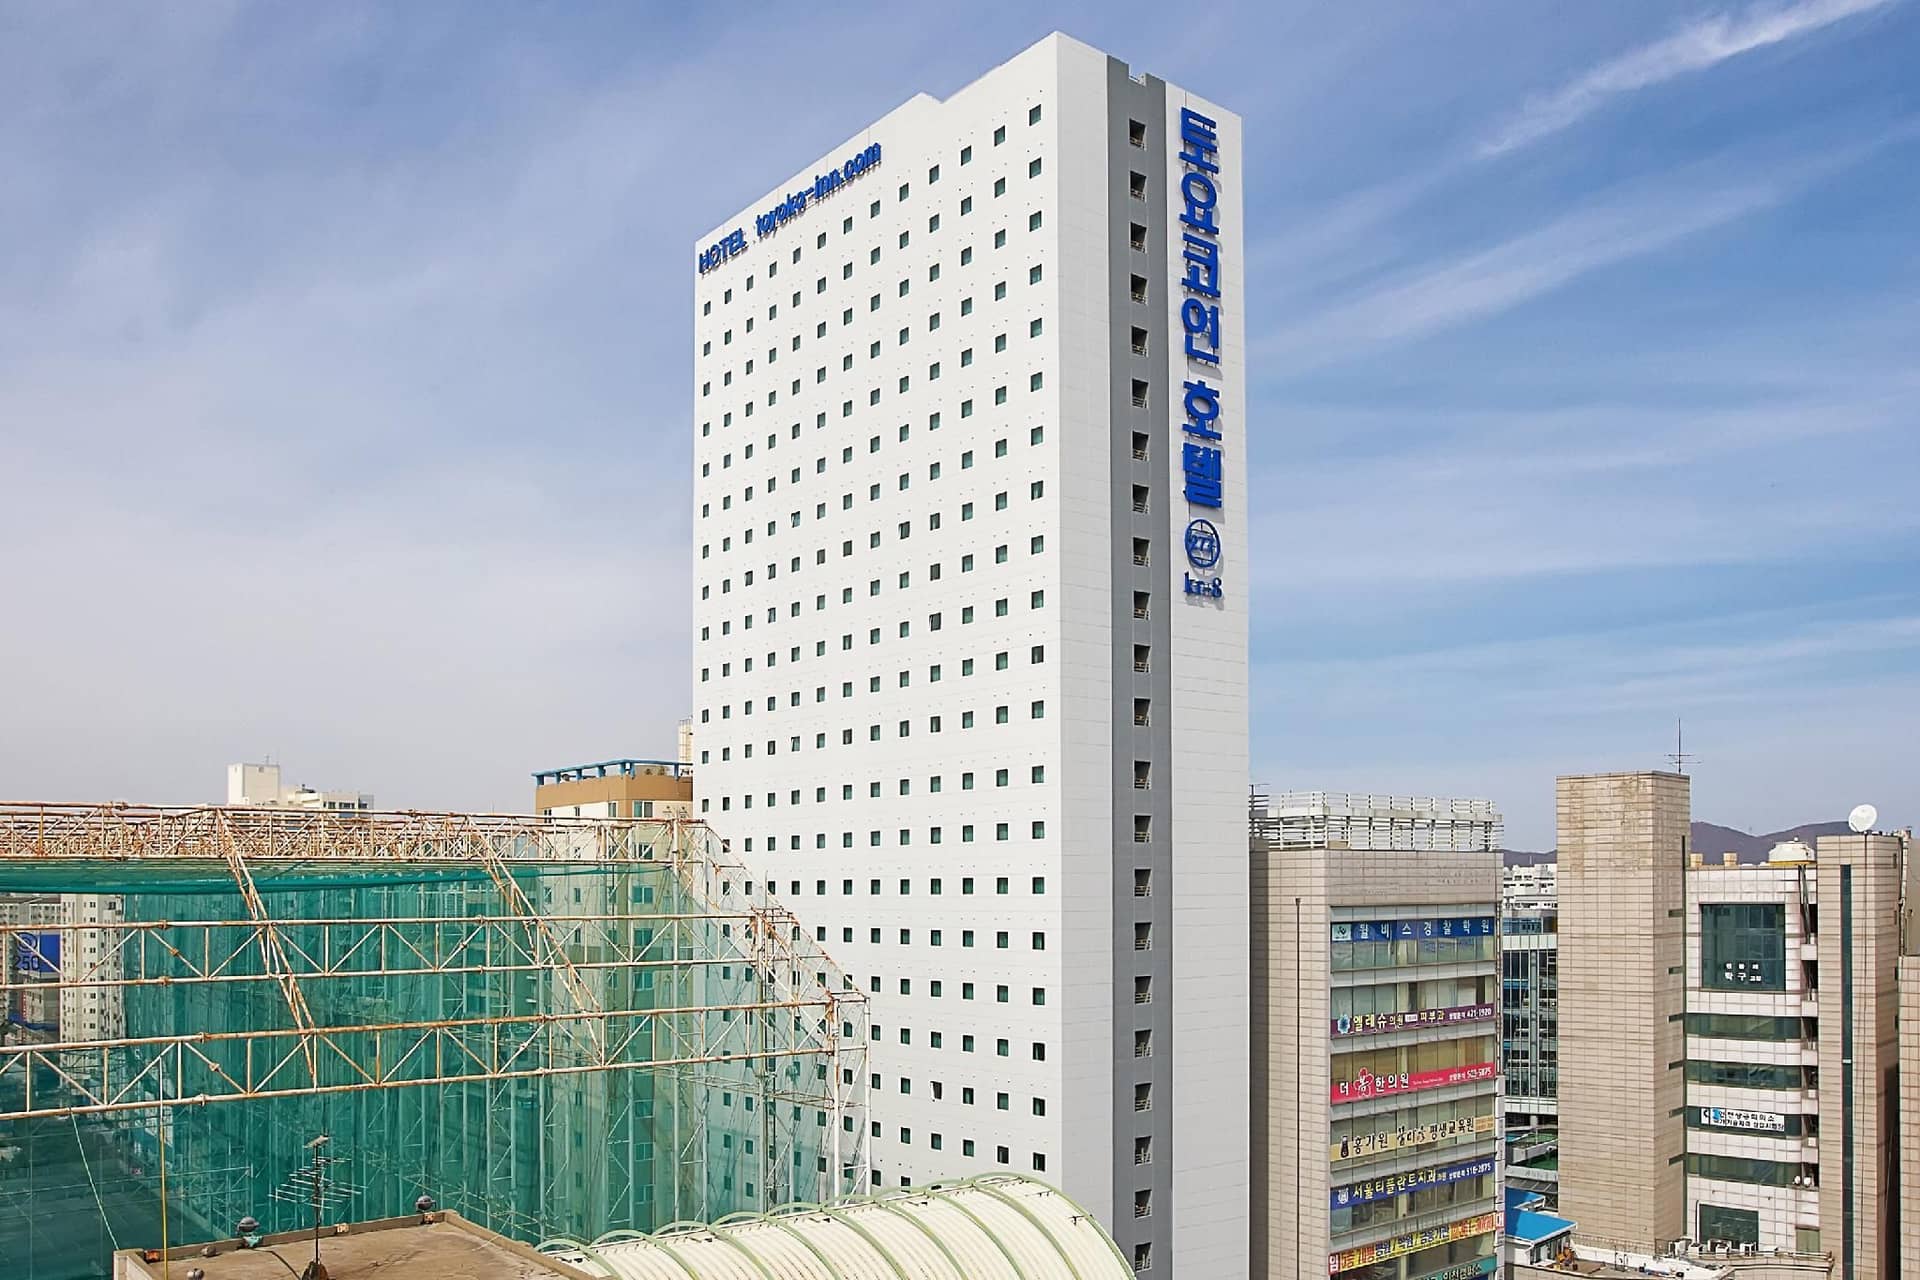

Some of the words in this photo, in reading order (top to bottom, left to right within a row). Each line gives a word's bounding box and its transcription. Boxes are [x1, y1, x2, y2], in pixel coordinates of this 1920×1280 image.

[699, 228, 747, 274] HOTEL
[756, 142, 882, 237] toyoko-inn.com
[1179, 106, 1221, 362] 토요코인
[1182, 380, 1222, 509] 호텔
[1430, 1117, 1474, 1140] 평생교육원
